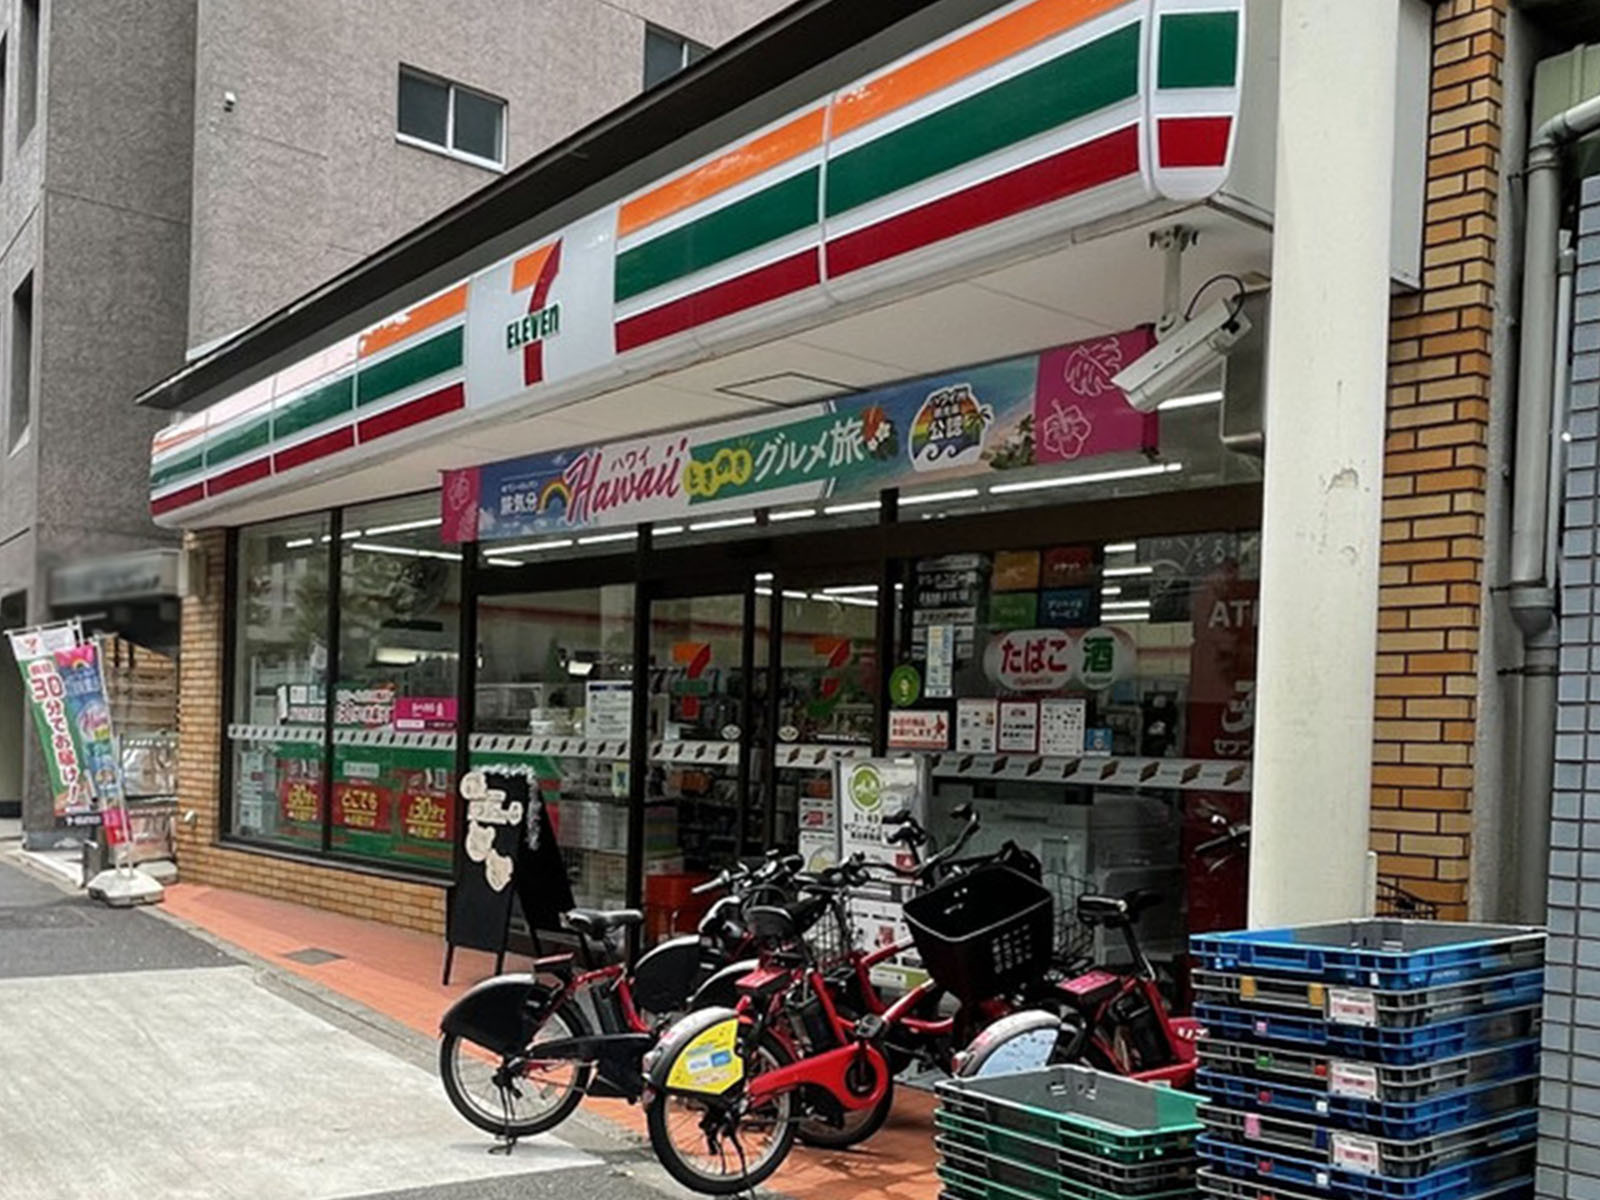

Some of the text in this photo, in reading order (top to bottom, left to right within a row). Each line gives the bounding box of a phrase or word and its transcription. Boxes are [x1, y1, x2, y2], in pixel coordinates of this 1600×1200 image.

[611, 446, 650, 472] ハワイ
[755, 416, 866, 483] グルメ旅
[565, 437, 688, 522] Hawaii
[1208, 599, 1258, 628] AT
[1001, 637, 1114, 674] たばこ 酒
